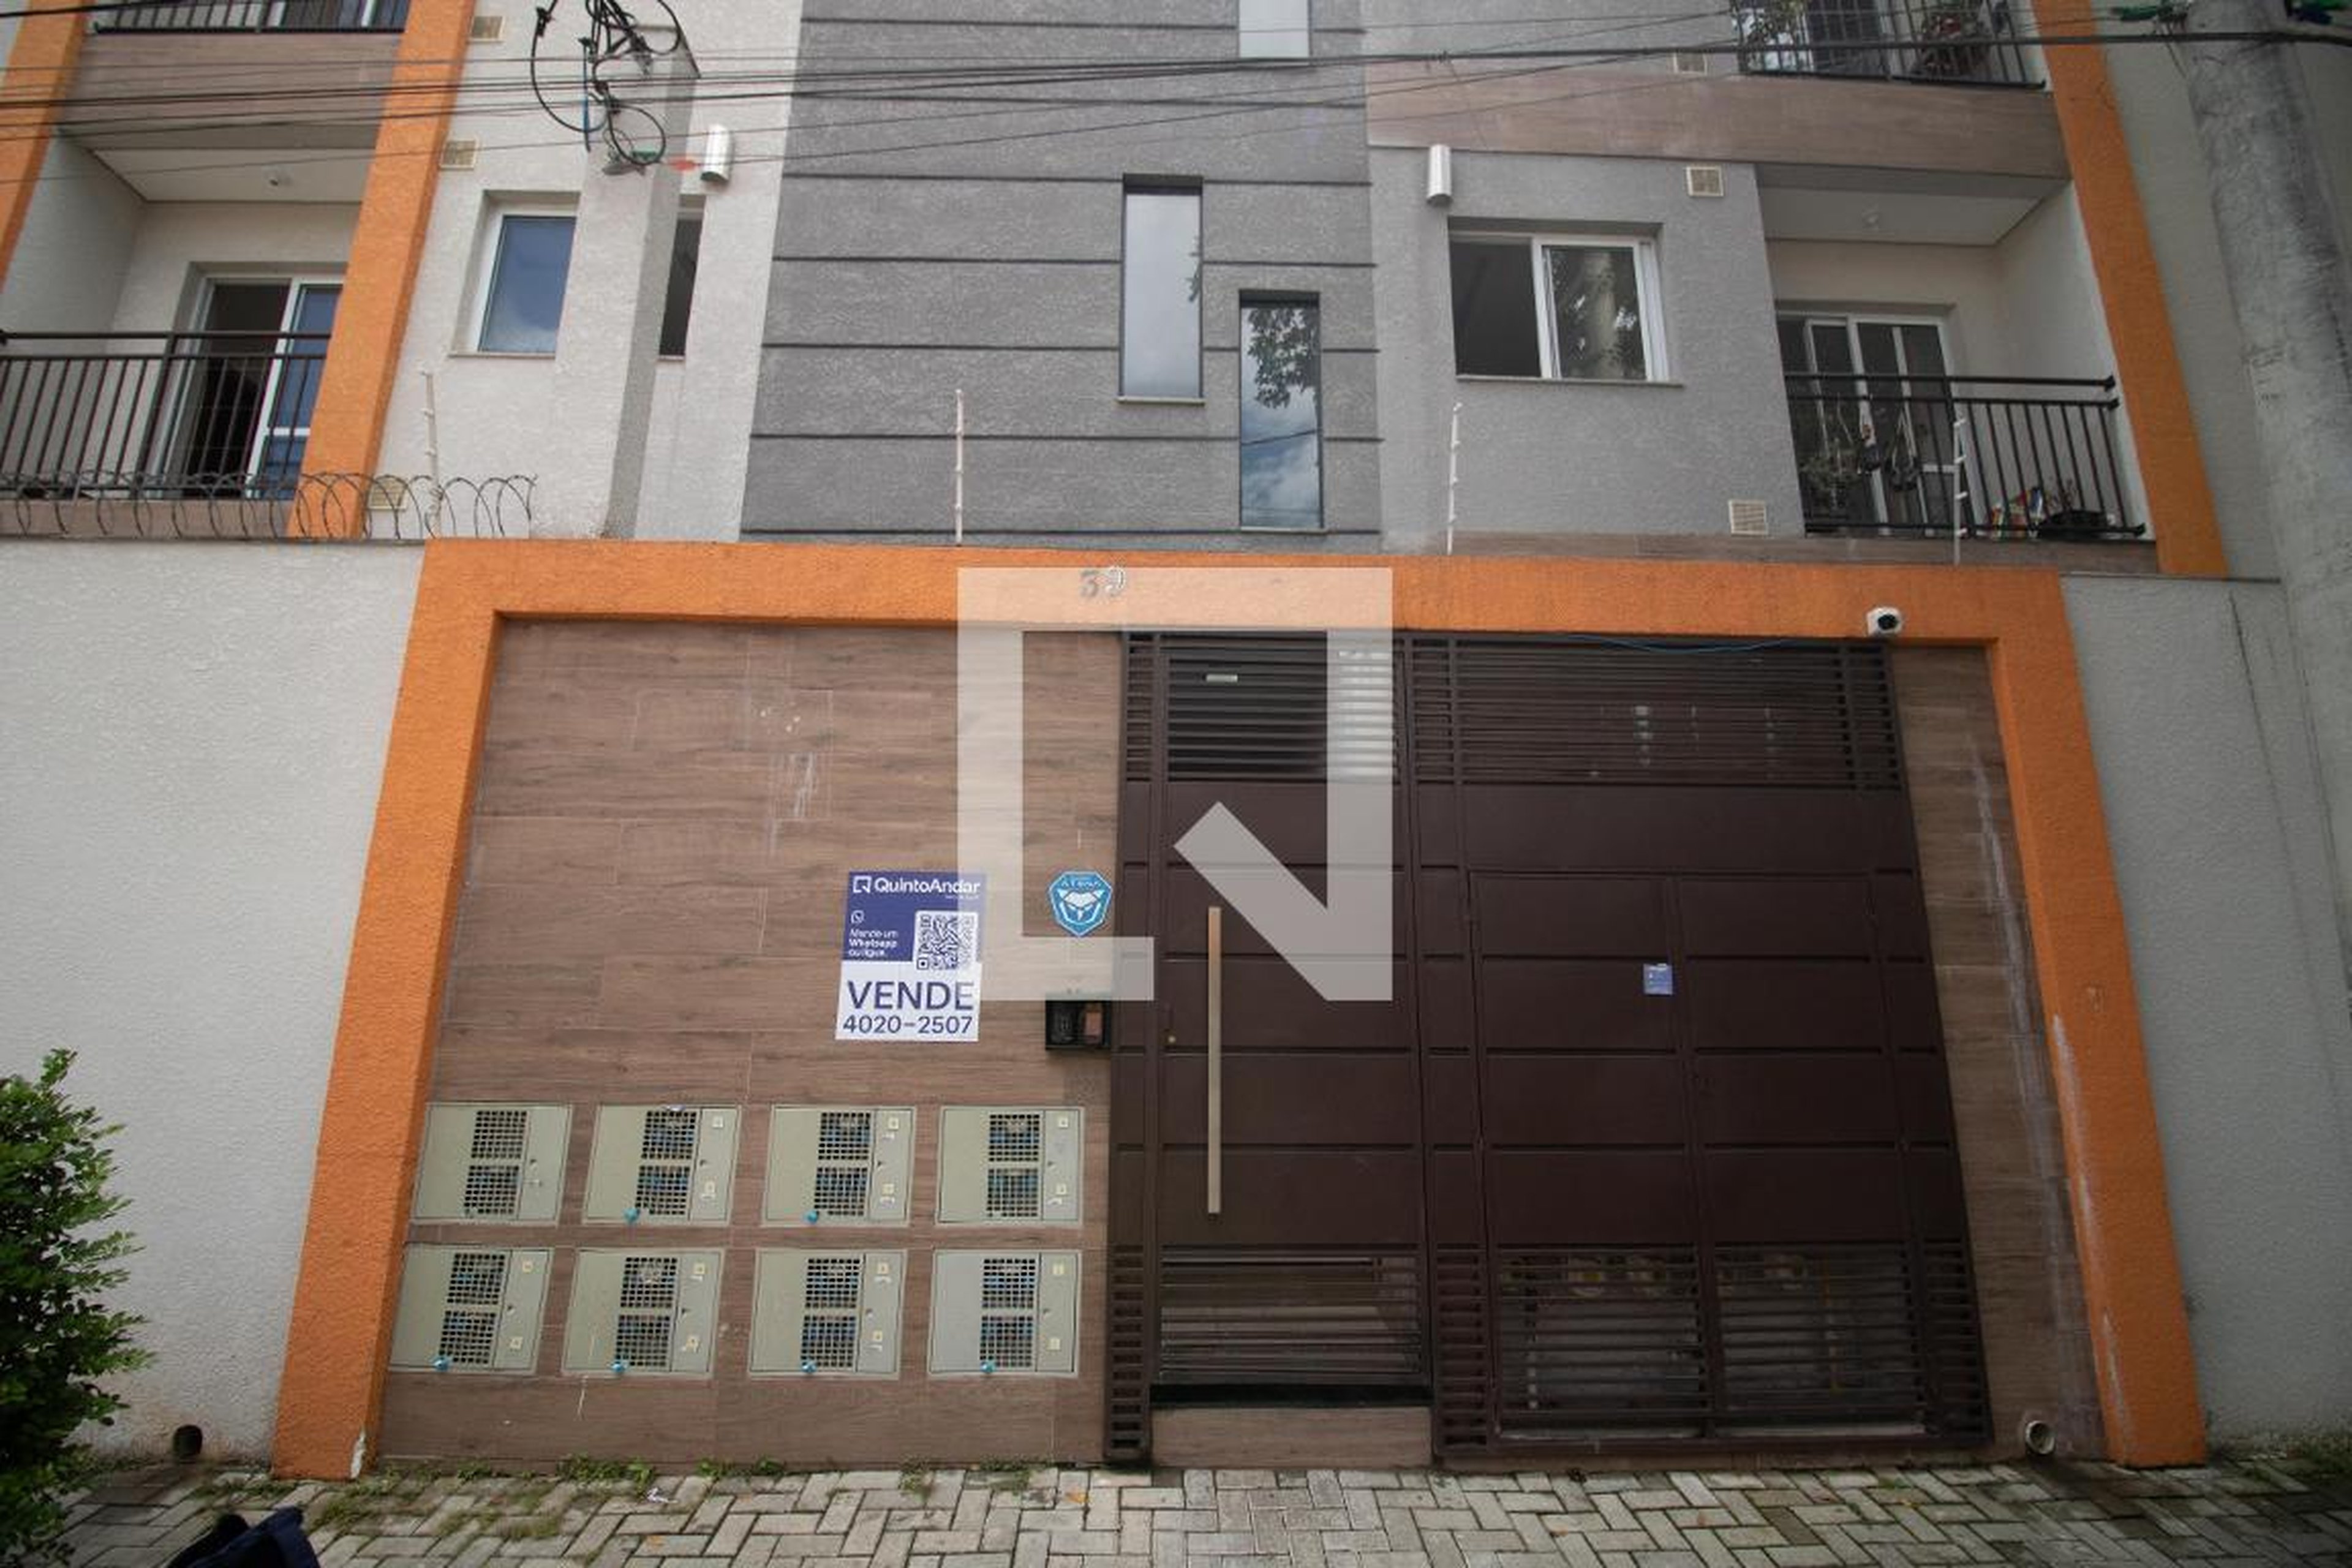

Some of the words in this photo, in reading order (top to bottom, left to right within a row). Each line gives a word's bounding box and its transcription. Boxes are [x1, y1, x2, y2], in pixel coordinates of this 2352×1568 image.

[874, 877, 980, 894] QuintoAndar
[848, 981, 974, 1011] VENDE
[843, 1015, 973, 1034] 4020-2507
